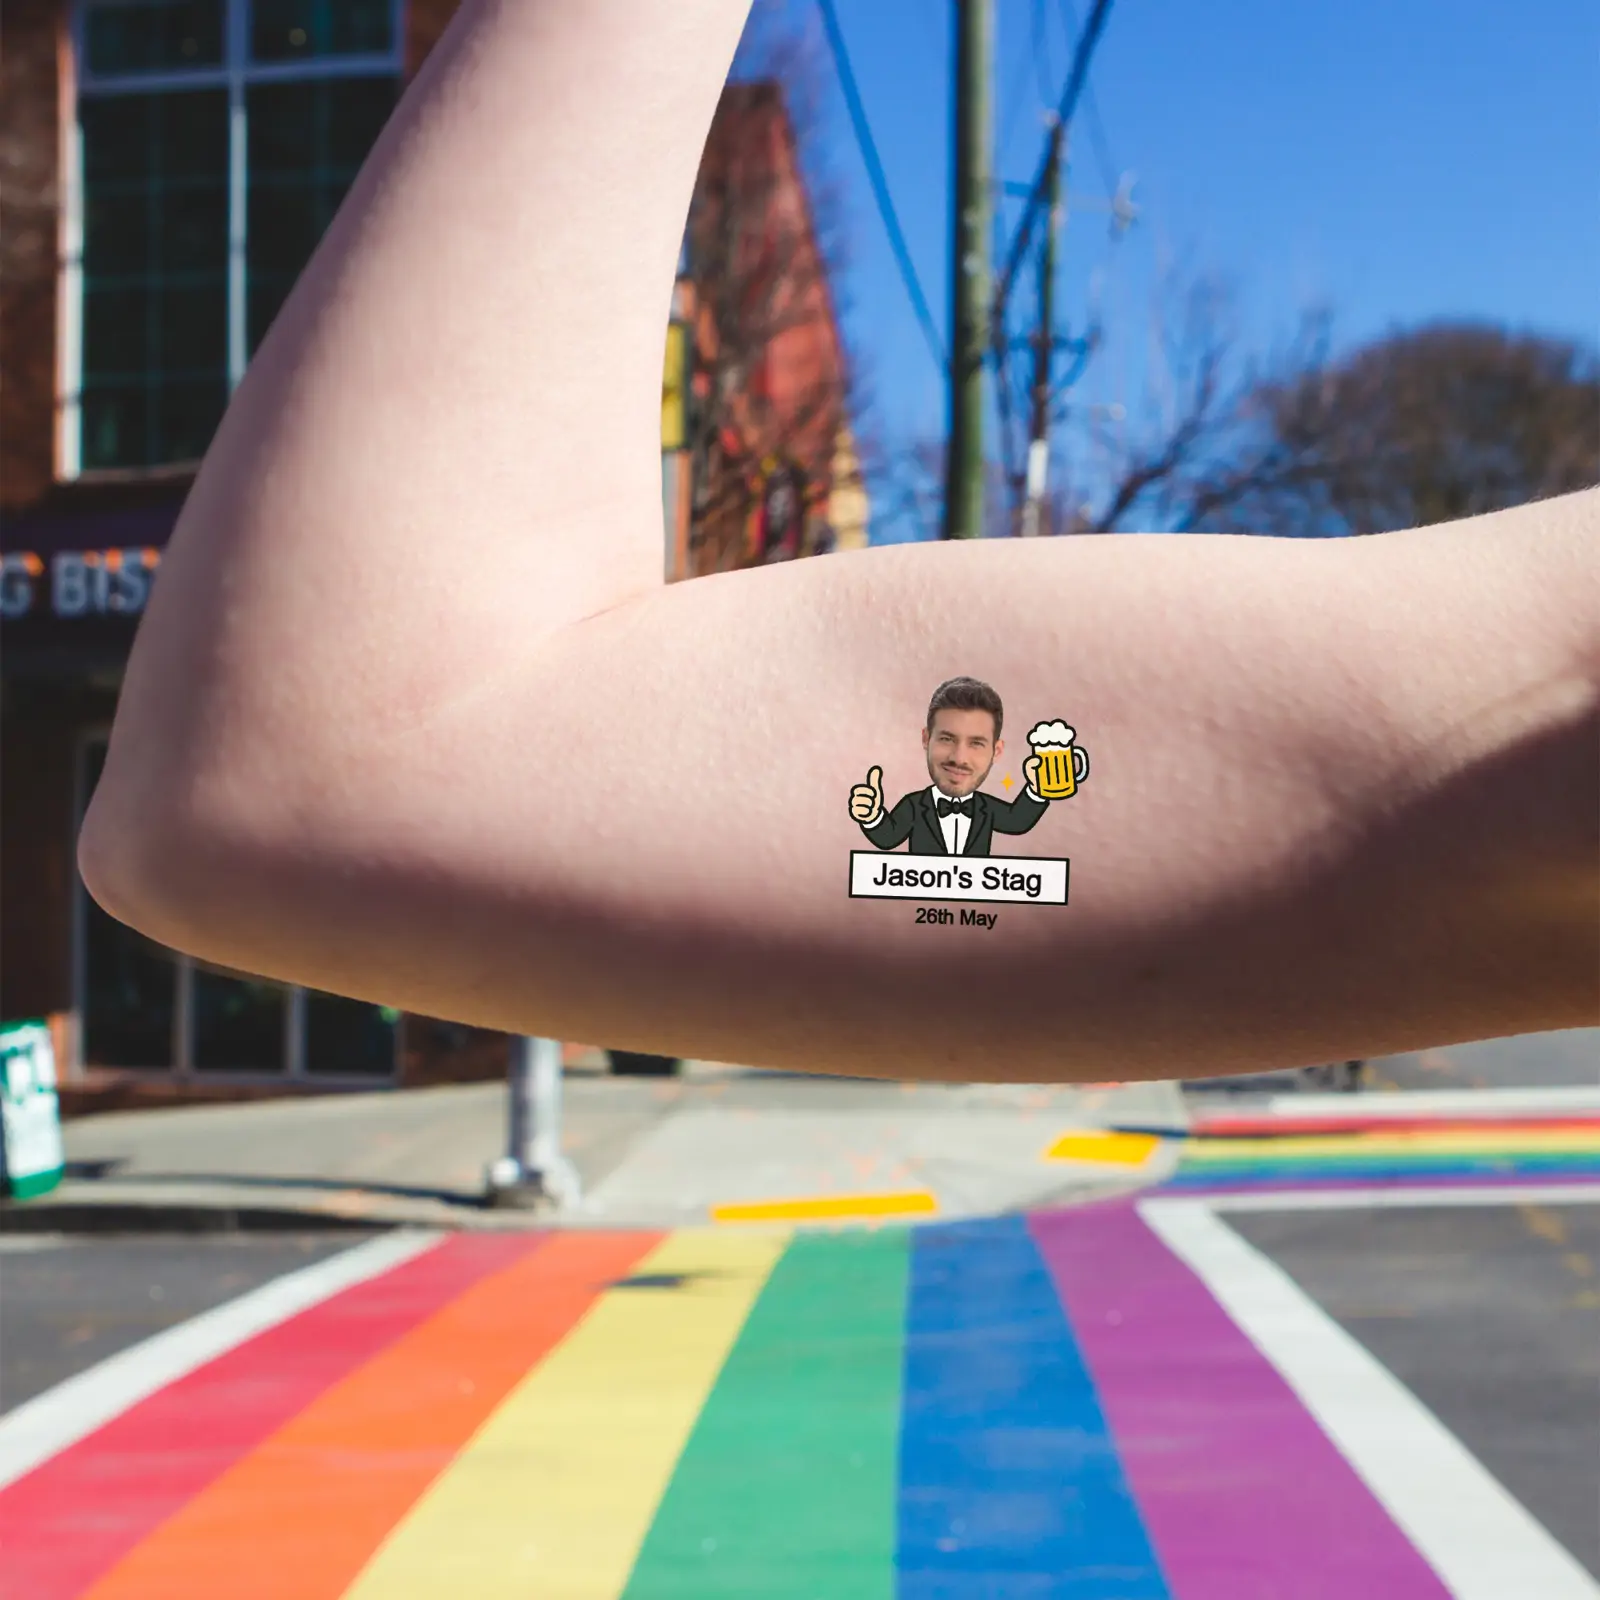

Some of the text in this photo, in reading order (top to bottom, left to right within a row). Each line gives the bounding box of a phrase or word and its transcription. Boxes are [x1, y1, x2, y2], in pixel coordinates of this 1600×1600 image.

[873, 862, 1042, 898] Jason's Stag
[915, 907, 998, 930] 26th May
